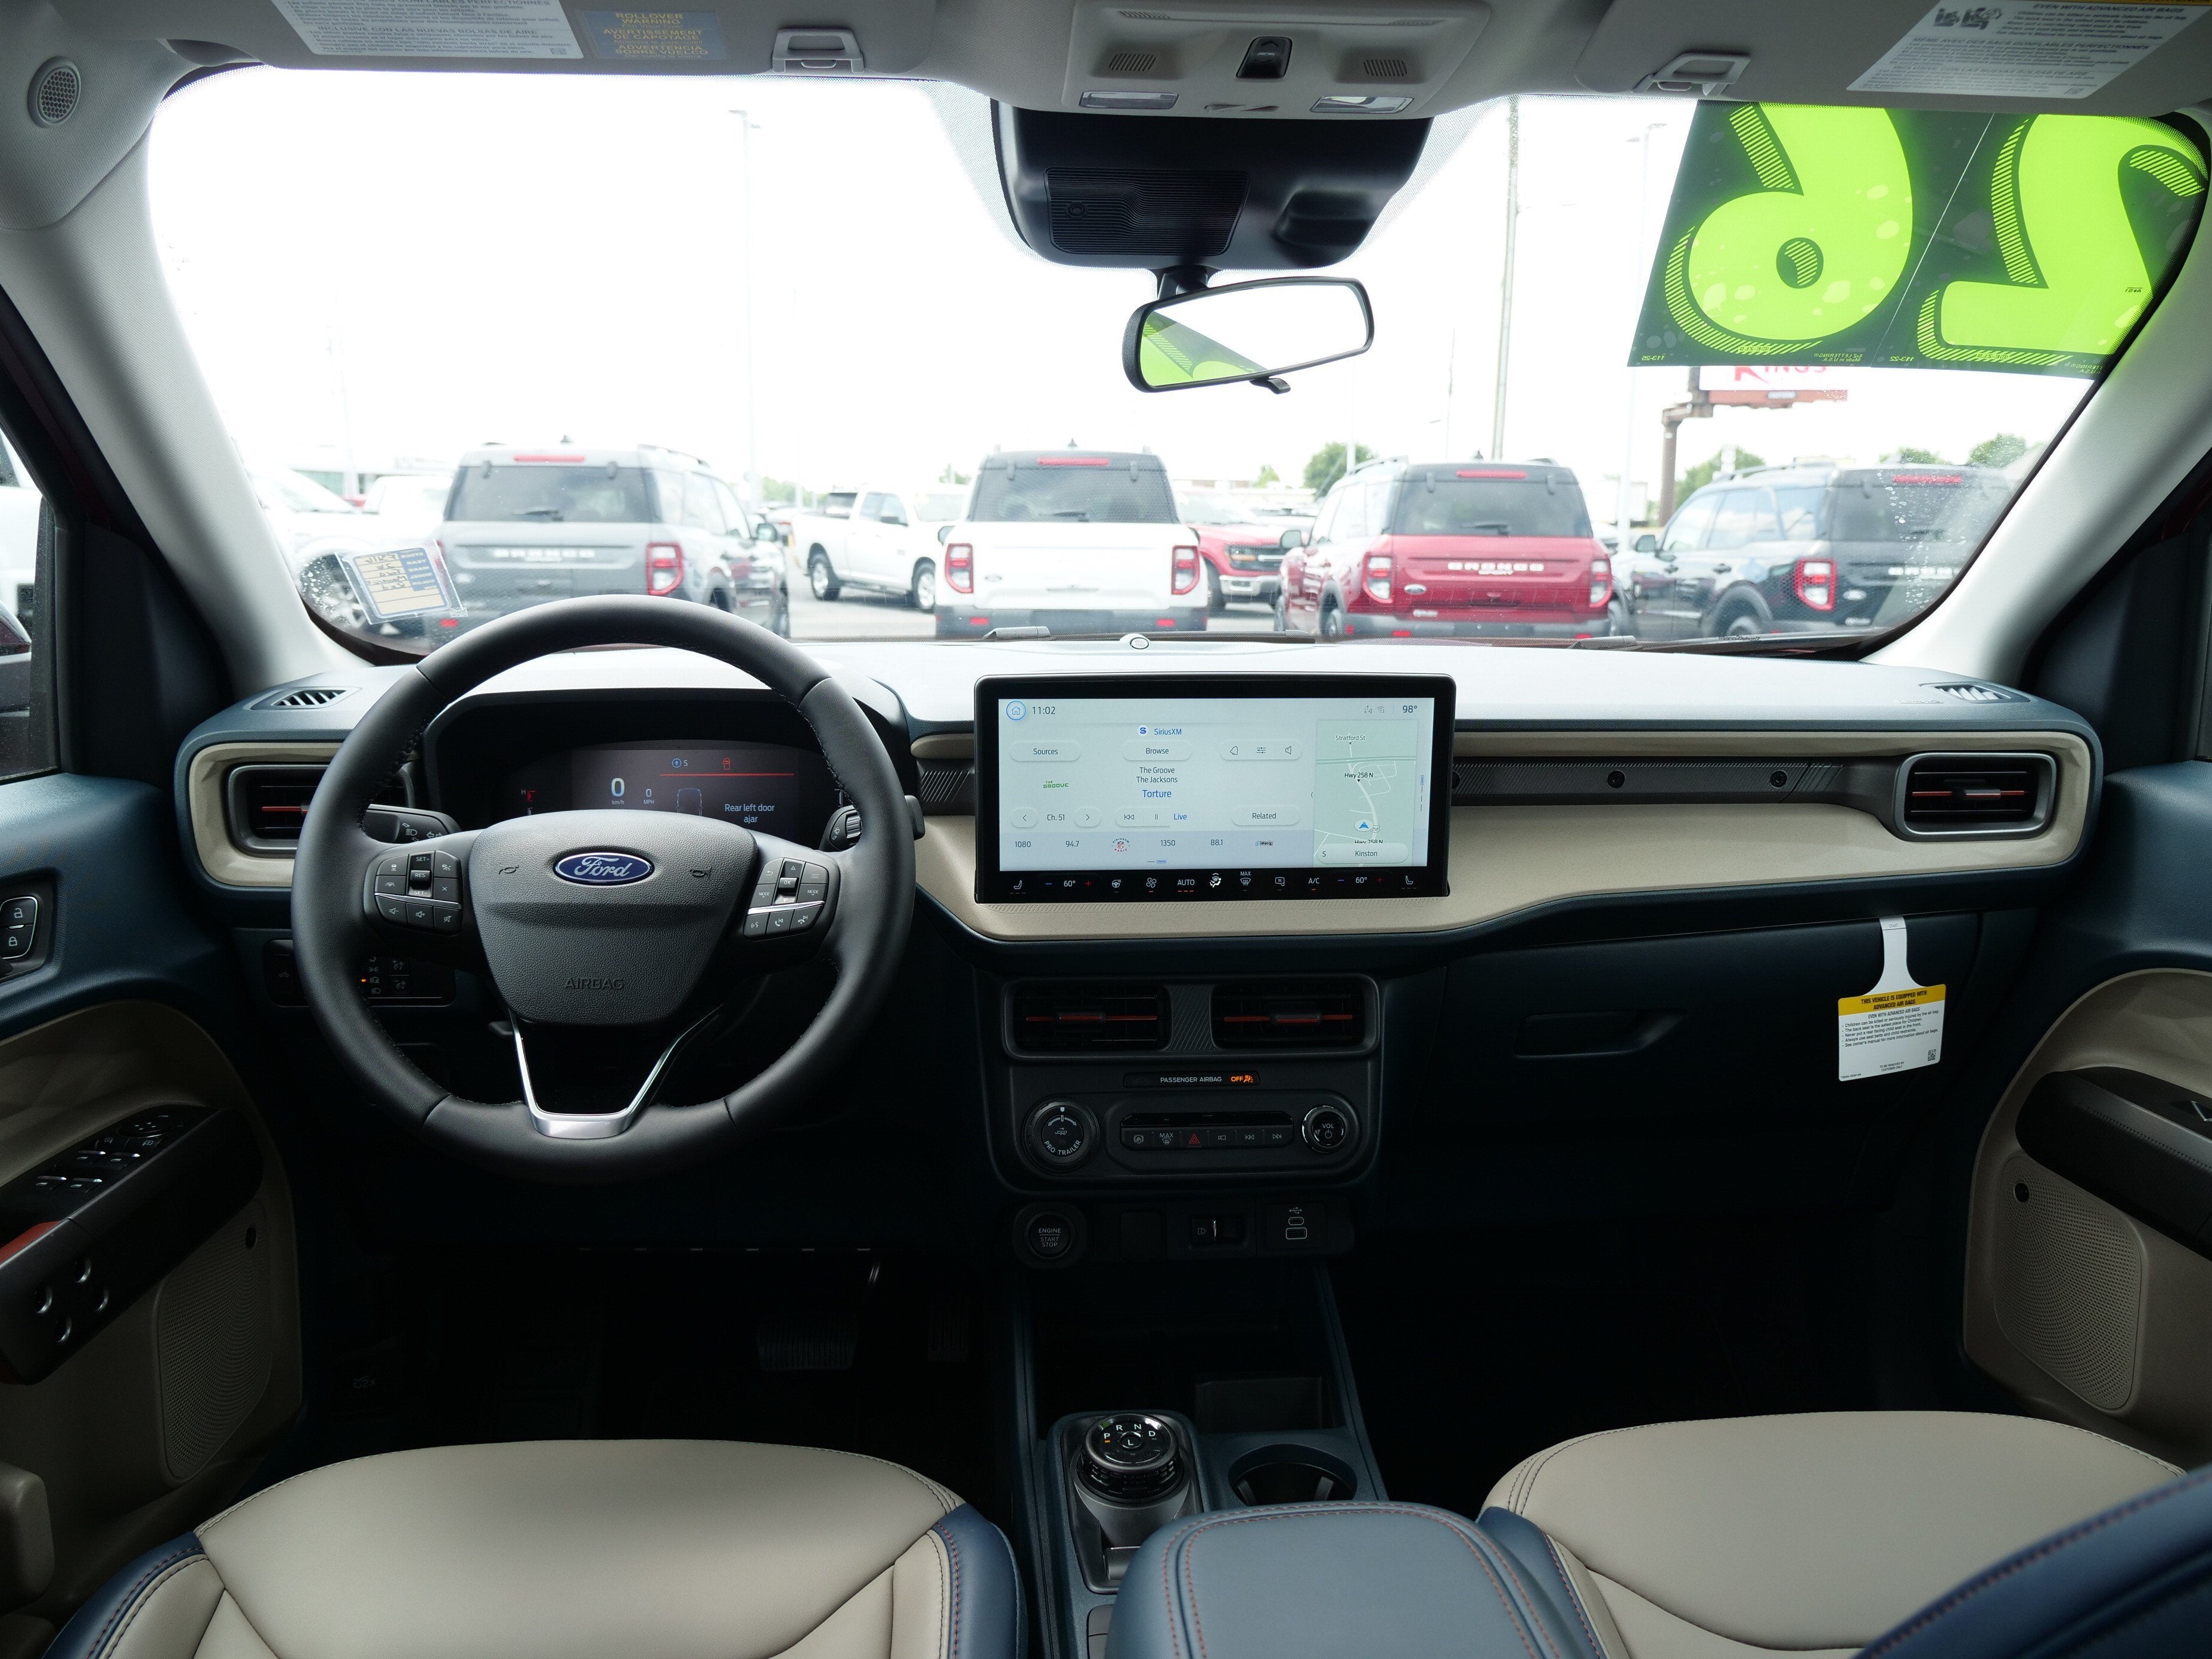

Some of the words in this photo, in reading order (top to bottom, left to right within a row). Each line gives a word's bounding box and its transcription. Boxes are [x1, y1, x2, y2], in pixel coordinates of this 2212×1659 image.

[1032, 706, 1056, 714] 11:02
[1403, 705, 1418, 713] 98°
[611, 778, 625, 797] 0
[645, 788, 652, 797] 0
[1142, 790, 1172, 798] Torture
[725, 803, 742, 812] Rear
[743, 803, 756, 812] left
[758, 803, 775, 812] door
[744, 814, 758, 824] ajar
[574, 856, 632, 877] Ford
[566, 977, 624, 989] AIRBAG
[1874, 1002, 1896, 1010] ADVANCED
[1044, 1140, 1056, 1152] PRO
[1058, 1140, 1082, 1155] TRAILER
